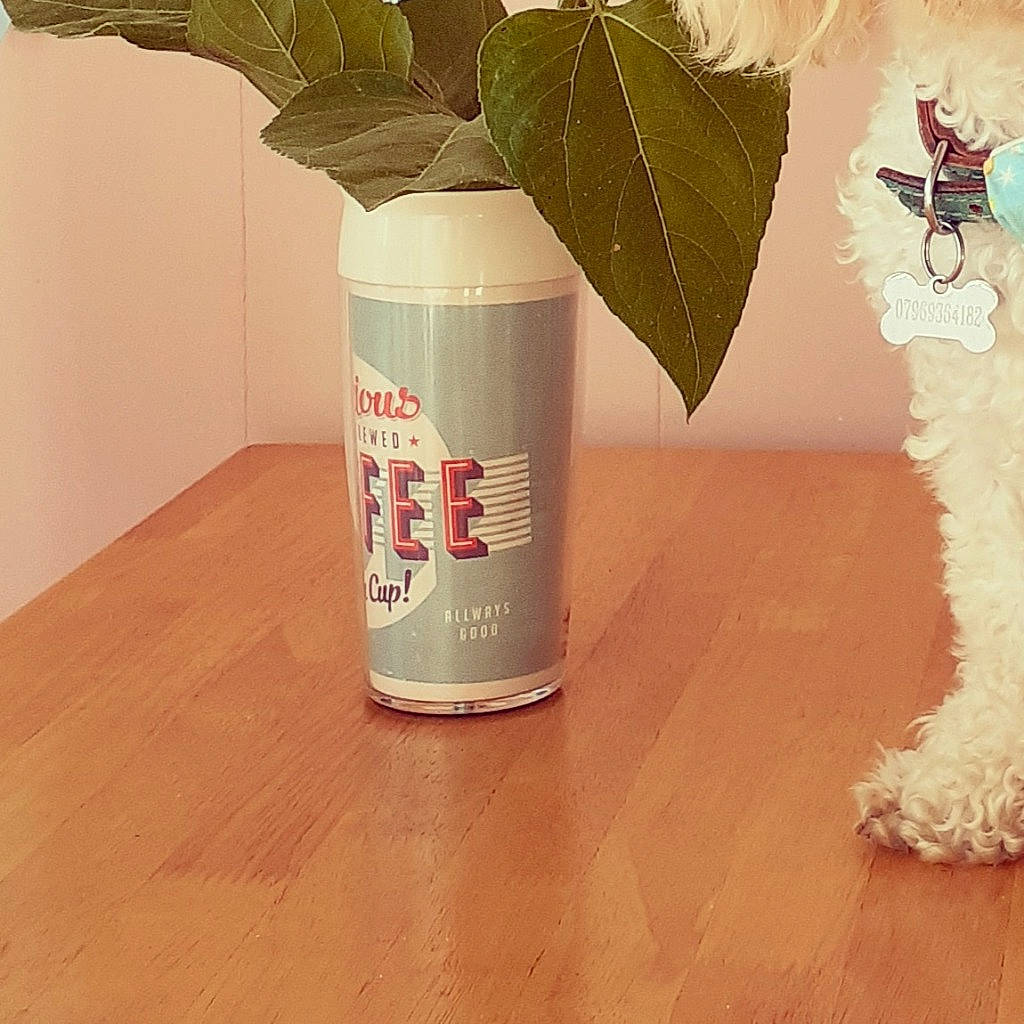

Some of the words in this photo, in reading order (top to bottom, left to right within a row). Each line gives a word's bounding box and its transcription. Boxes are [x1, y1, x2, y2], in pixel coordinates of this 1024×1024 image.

[369, 569, 412, 612] Cup!
[445, 602, 510, 624] ALLWAYS
[460, 623, 498, 641] GOOD
